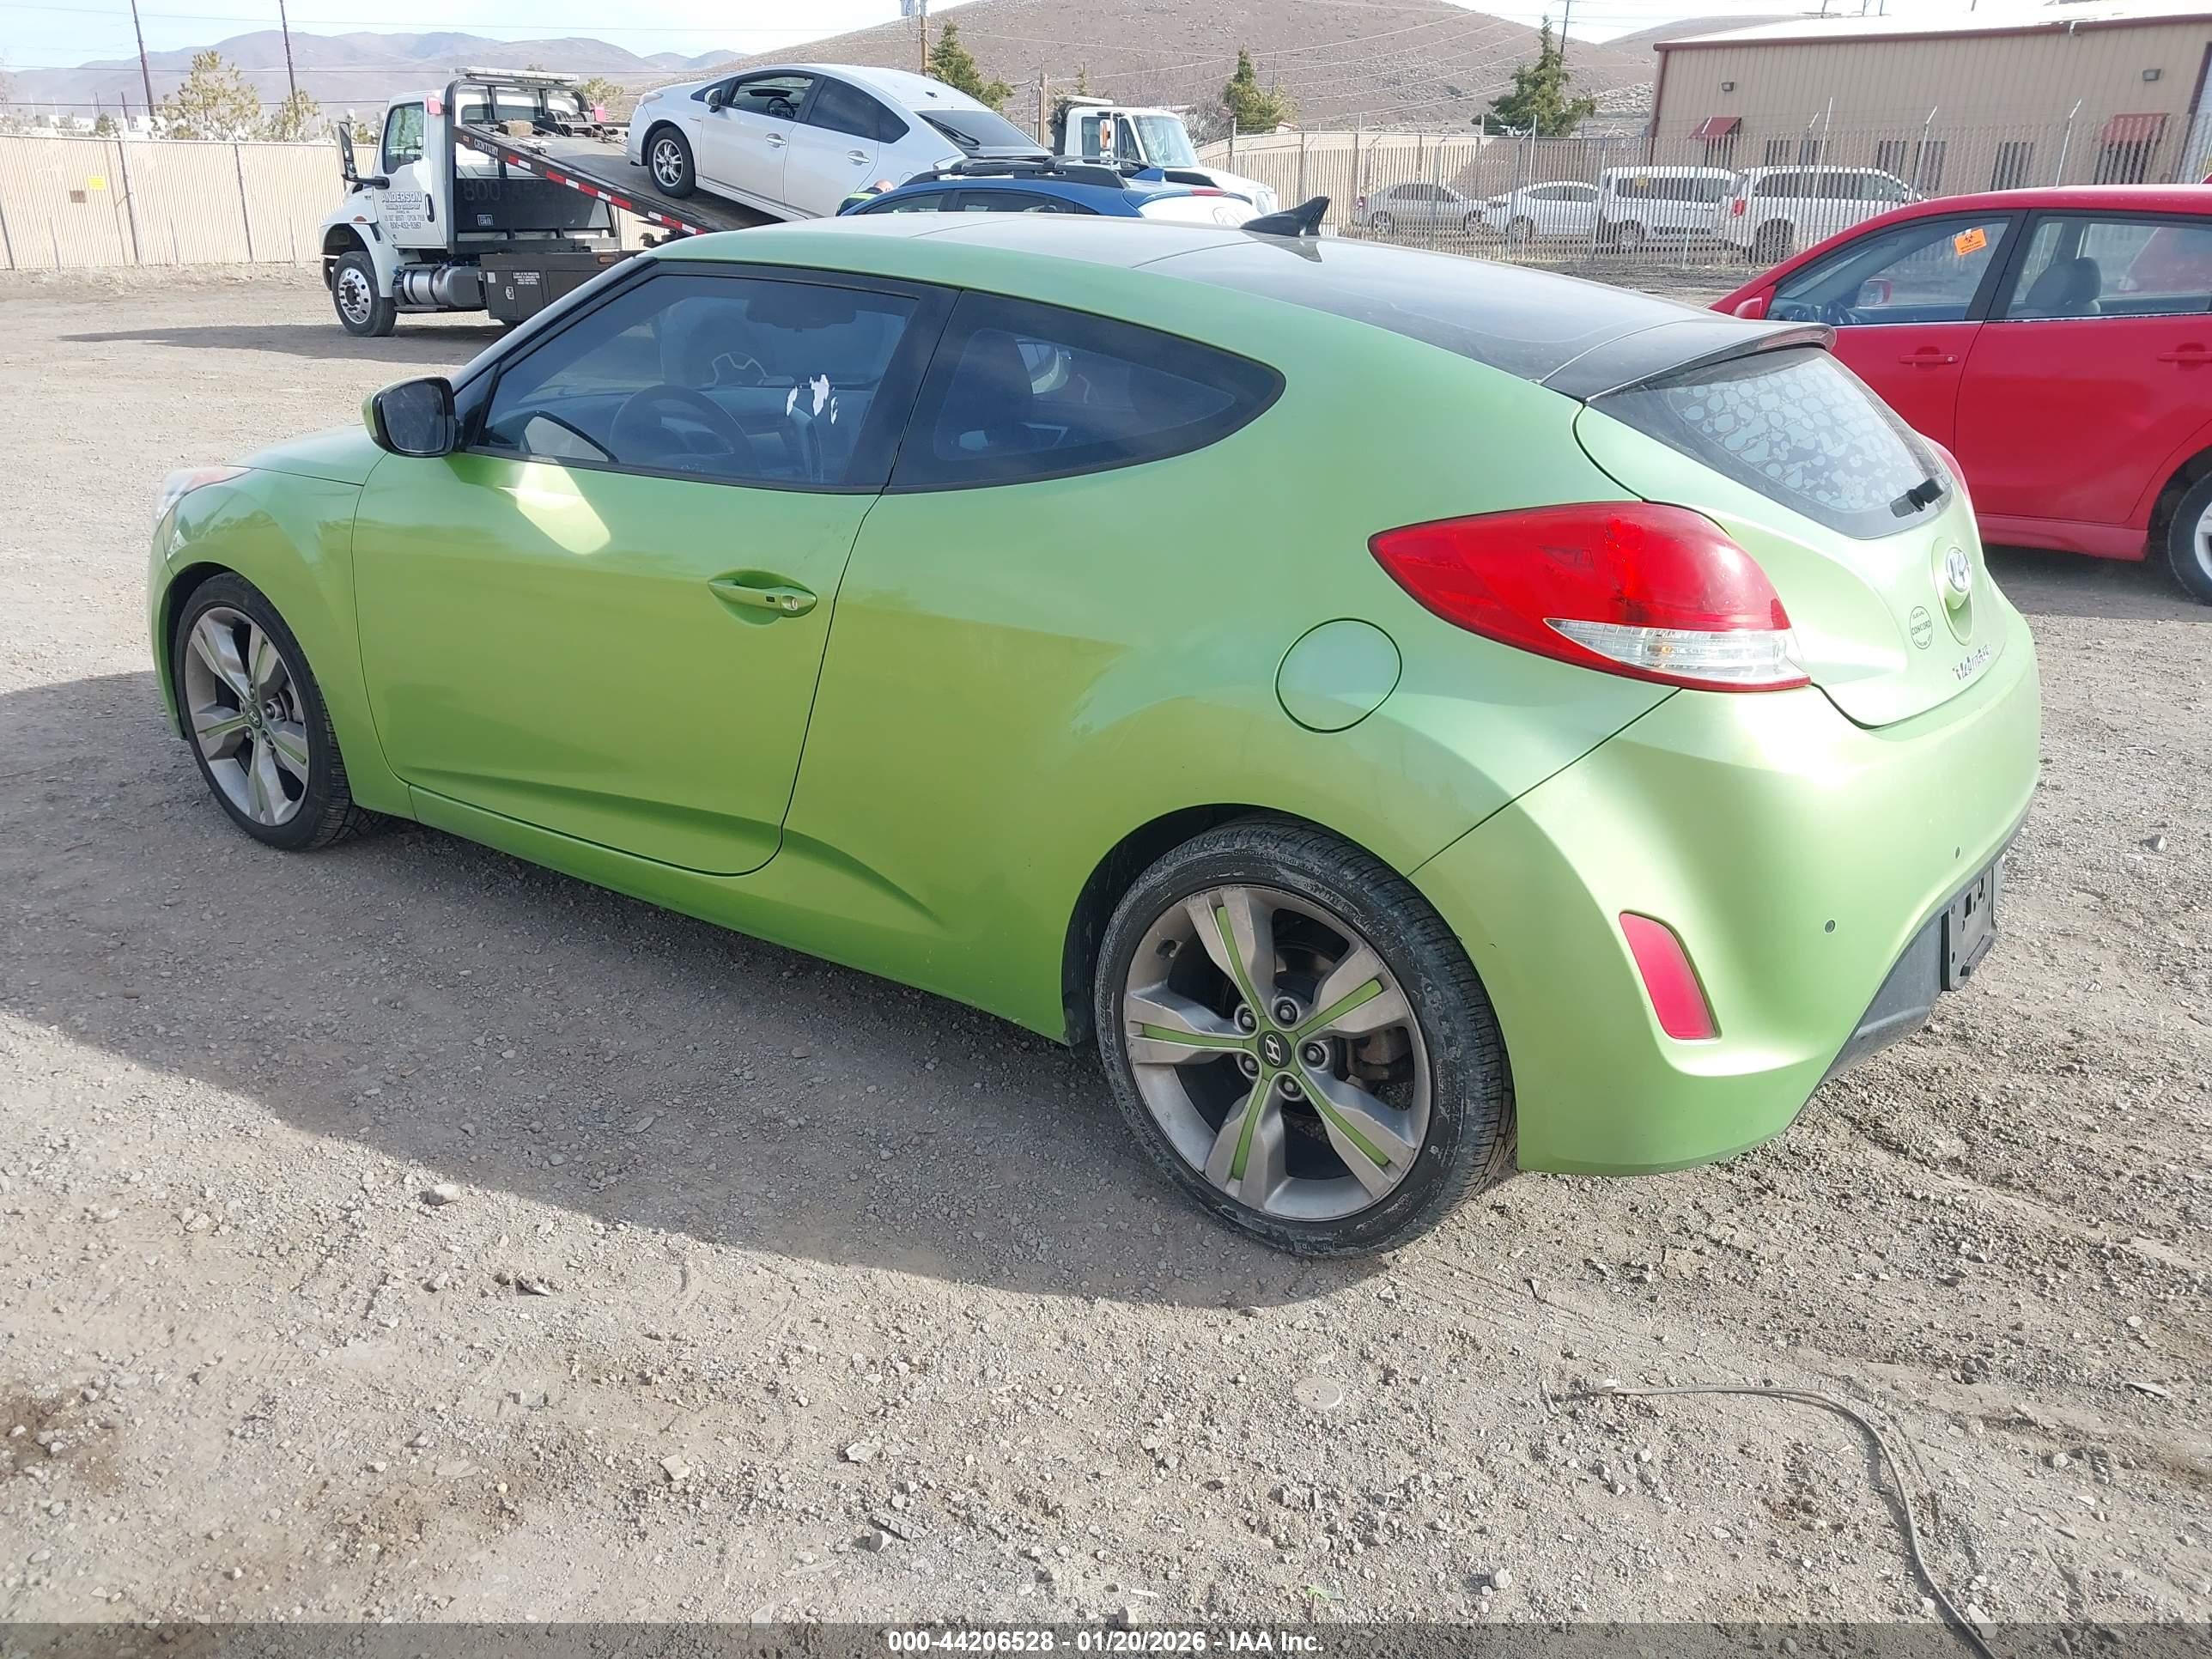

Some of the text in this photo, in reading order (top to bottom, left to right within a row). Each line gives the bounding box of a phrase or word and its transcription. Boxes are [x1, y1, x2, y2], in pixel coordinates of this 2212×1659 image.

[473, 138, 499, 156] CENTURY
[381, 191, 422, 203] ANDERSON
[1911, 619, 1931, 635] CONCORD
